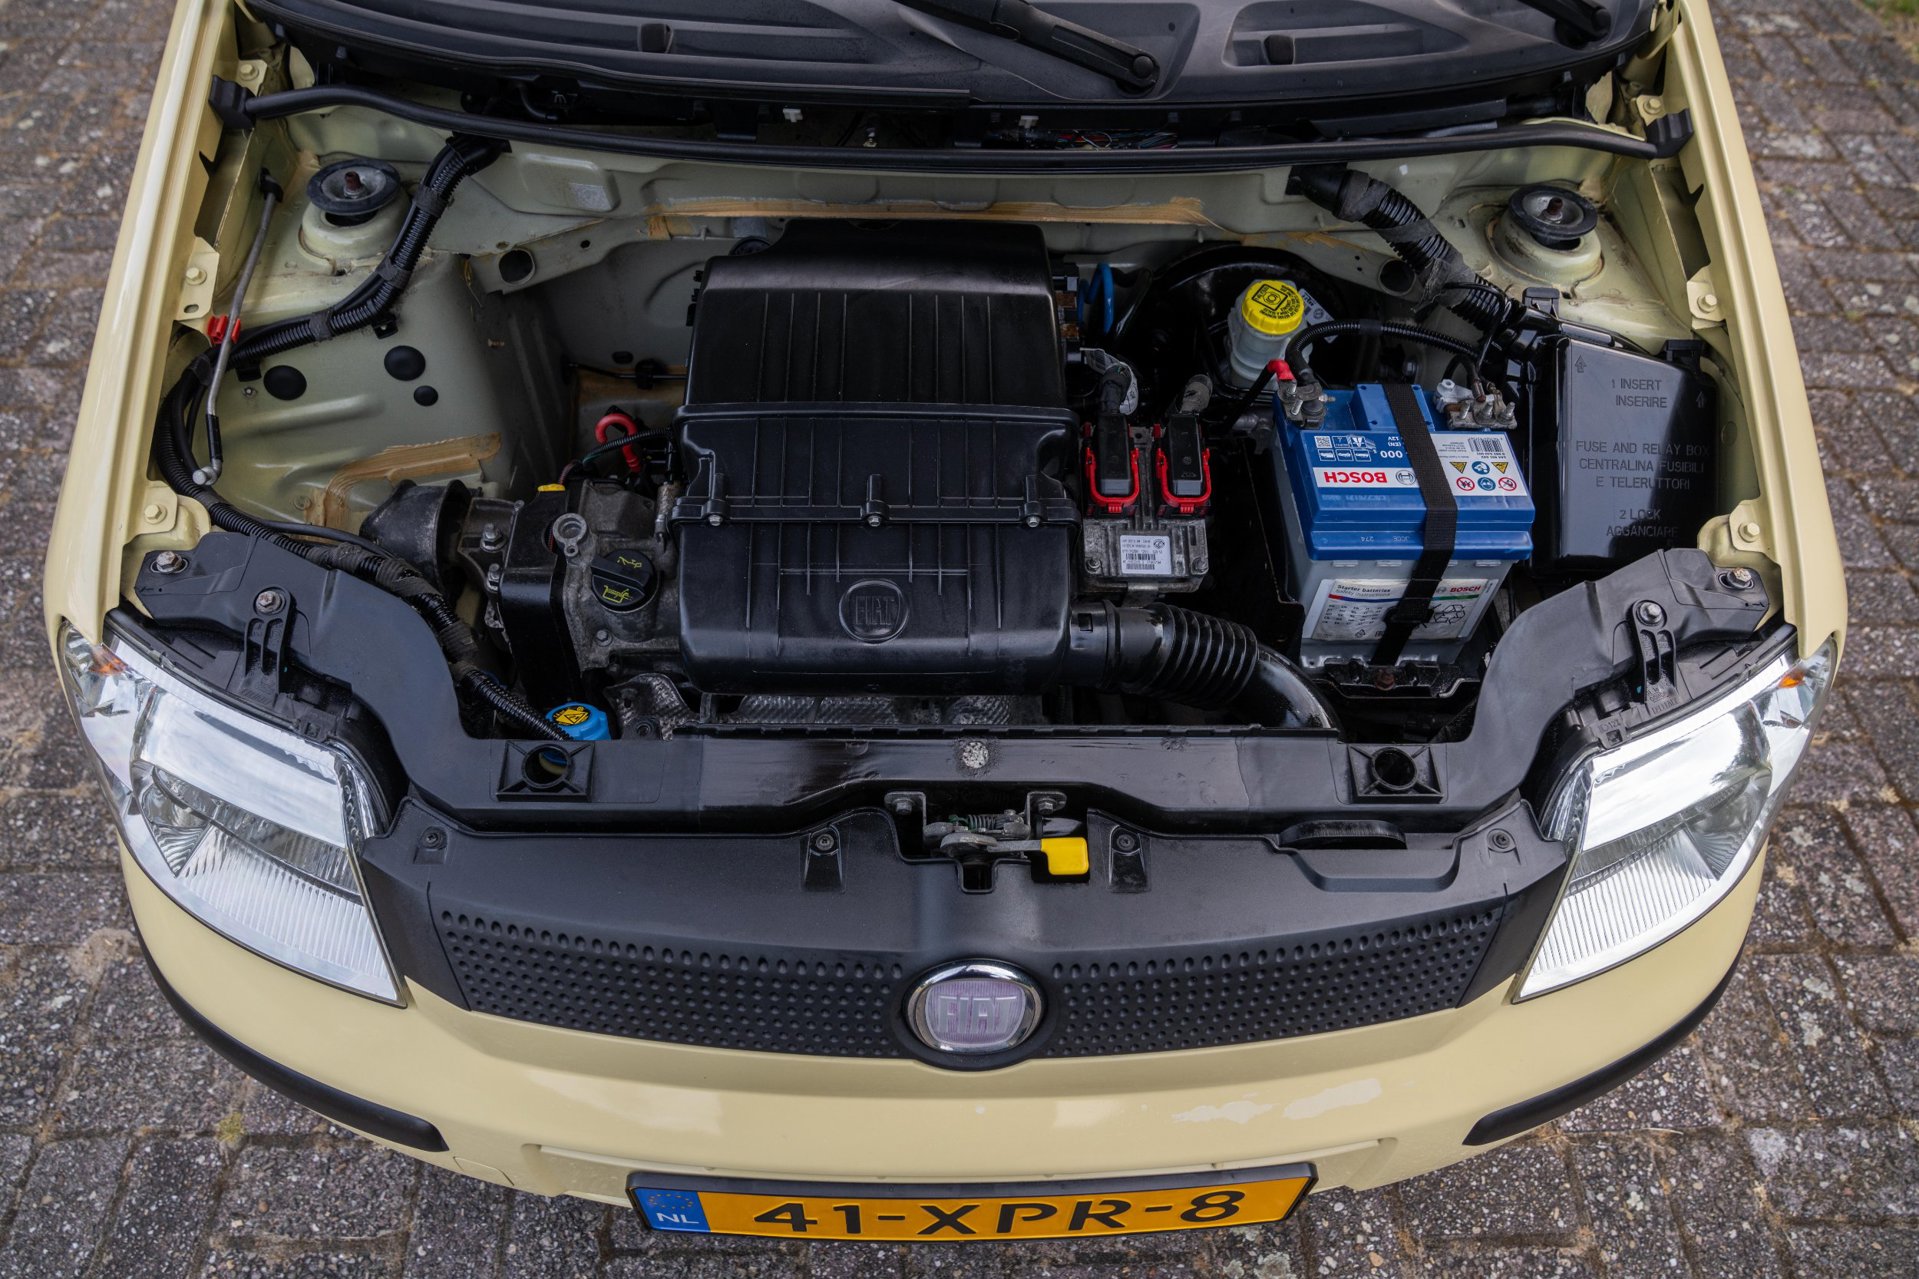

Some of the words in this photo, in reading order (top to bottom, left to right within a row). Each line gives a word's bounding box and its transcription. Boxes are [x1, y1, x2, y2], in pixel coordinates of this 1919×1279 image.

[1620, 378, 1662, 391] INSERT
[1615, 395, 1668, 408] INSERIRE
[1576, 440, 1607, 452] FUSE
[1612, 442, 1637, 454] AND
[1642, 443, 1681, 456] RELAY
[1579, 458, 1654, 471] CENTRALINA
[1659, 460, 1704, 473] FUSIBILI
[1323, 471, 1388, 483] BOSCH
[1596, 476, 1605, 487] E
[1610, 476, 1690, 490] TELERUTTORI
[1619, 509, 1626, 520] 2
[1629, 509, 1662, 520] LOCK
[1606, 525, 1679, 537] AGGANCIARE
[1337, 584, 1360, 592] Starter
[1449, 585, 1482, 593] BOSCH
[855, 595, 895, 625] FIAT
[938, 995, 1017, 1034] FIAT
[656, 1212, 699, 1225] NL
[753, 1190, 1246, 1235] 41-XPR-8
